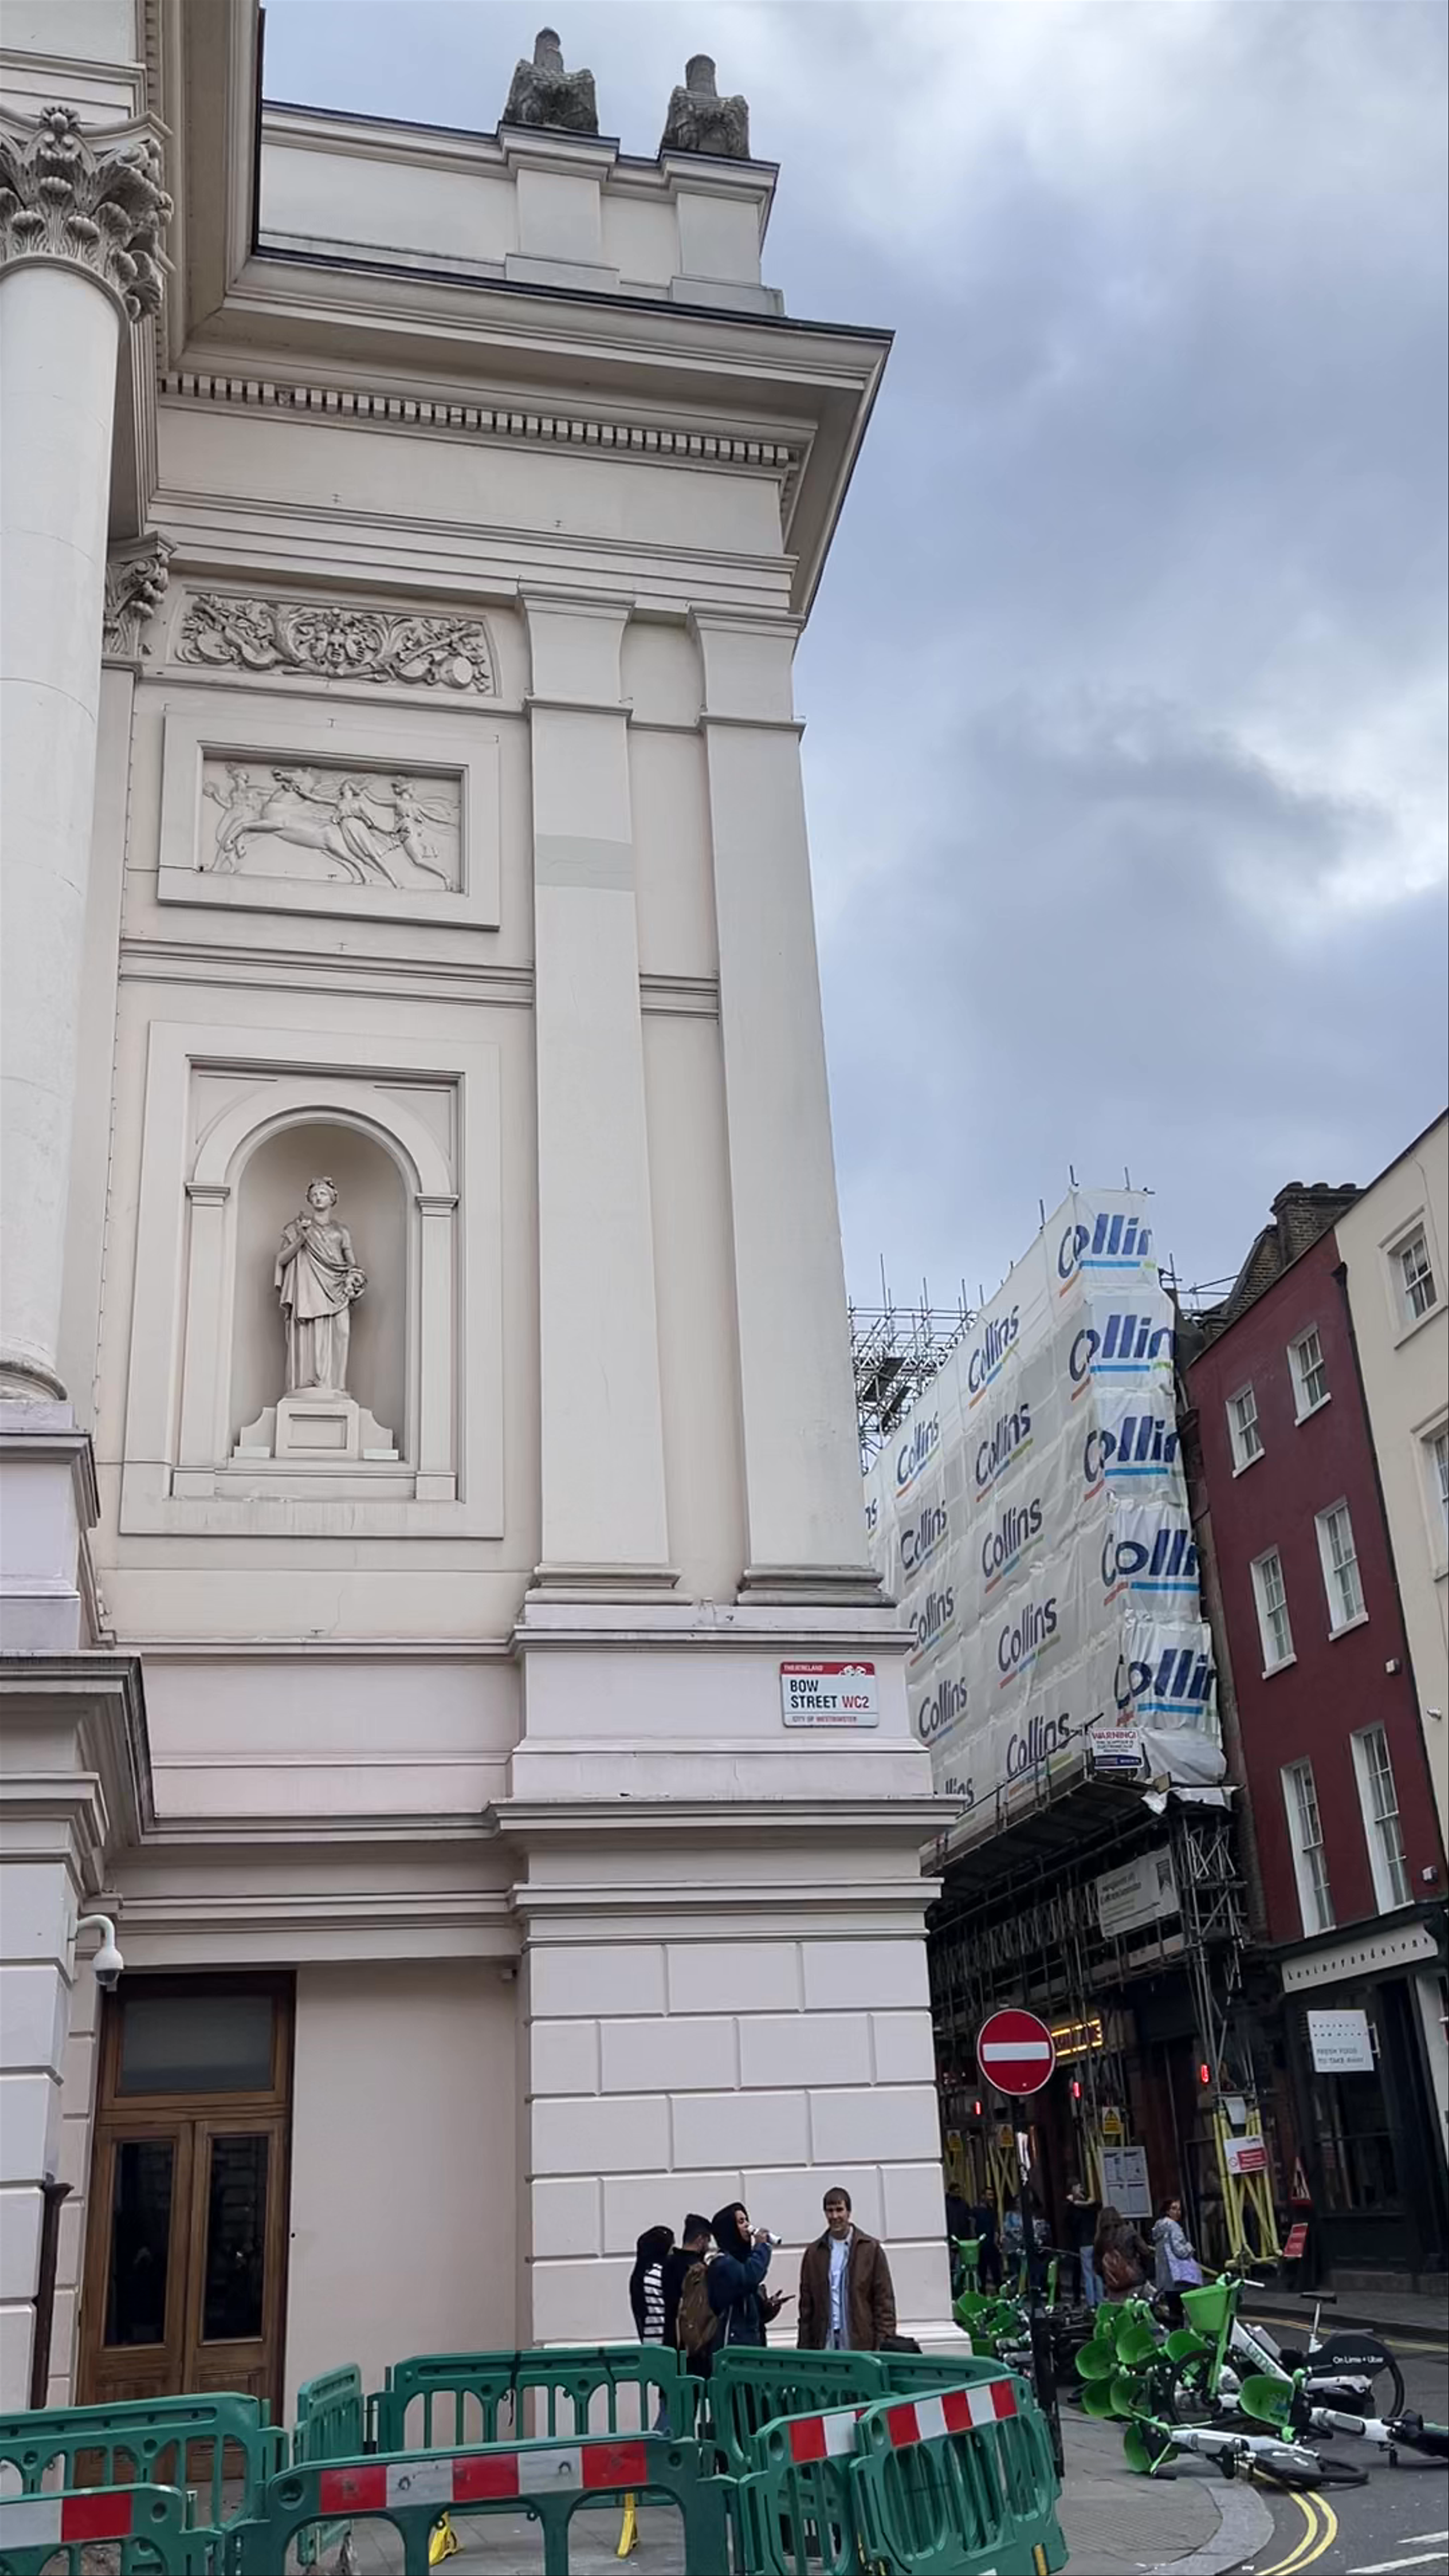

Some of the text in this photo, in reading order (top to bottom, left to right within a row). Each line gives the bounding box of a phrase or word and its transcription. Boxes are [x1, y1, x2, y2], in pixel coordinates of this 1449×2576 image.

[969, 1305, 1019, 1393] Collins
[897, 1410, 938, 1485] Collins
[976, 1403, 1031, 1486] Collins
[901, 1500, 947, 1570] Collins
[982, 1498, 1042, 1578] Collins
[998, 1597, 1057, 1672] Collins
[791, 1679, 818, 1692] BOW
[791, 1695, 869, 1708] STREET WC2
[919, 1677, 967, 1737] Collins
[1007, 1713, 1069, 1778] Collins
[1246, 2342, 1277, 2376] Lime
